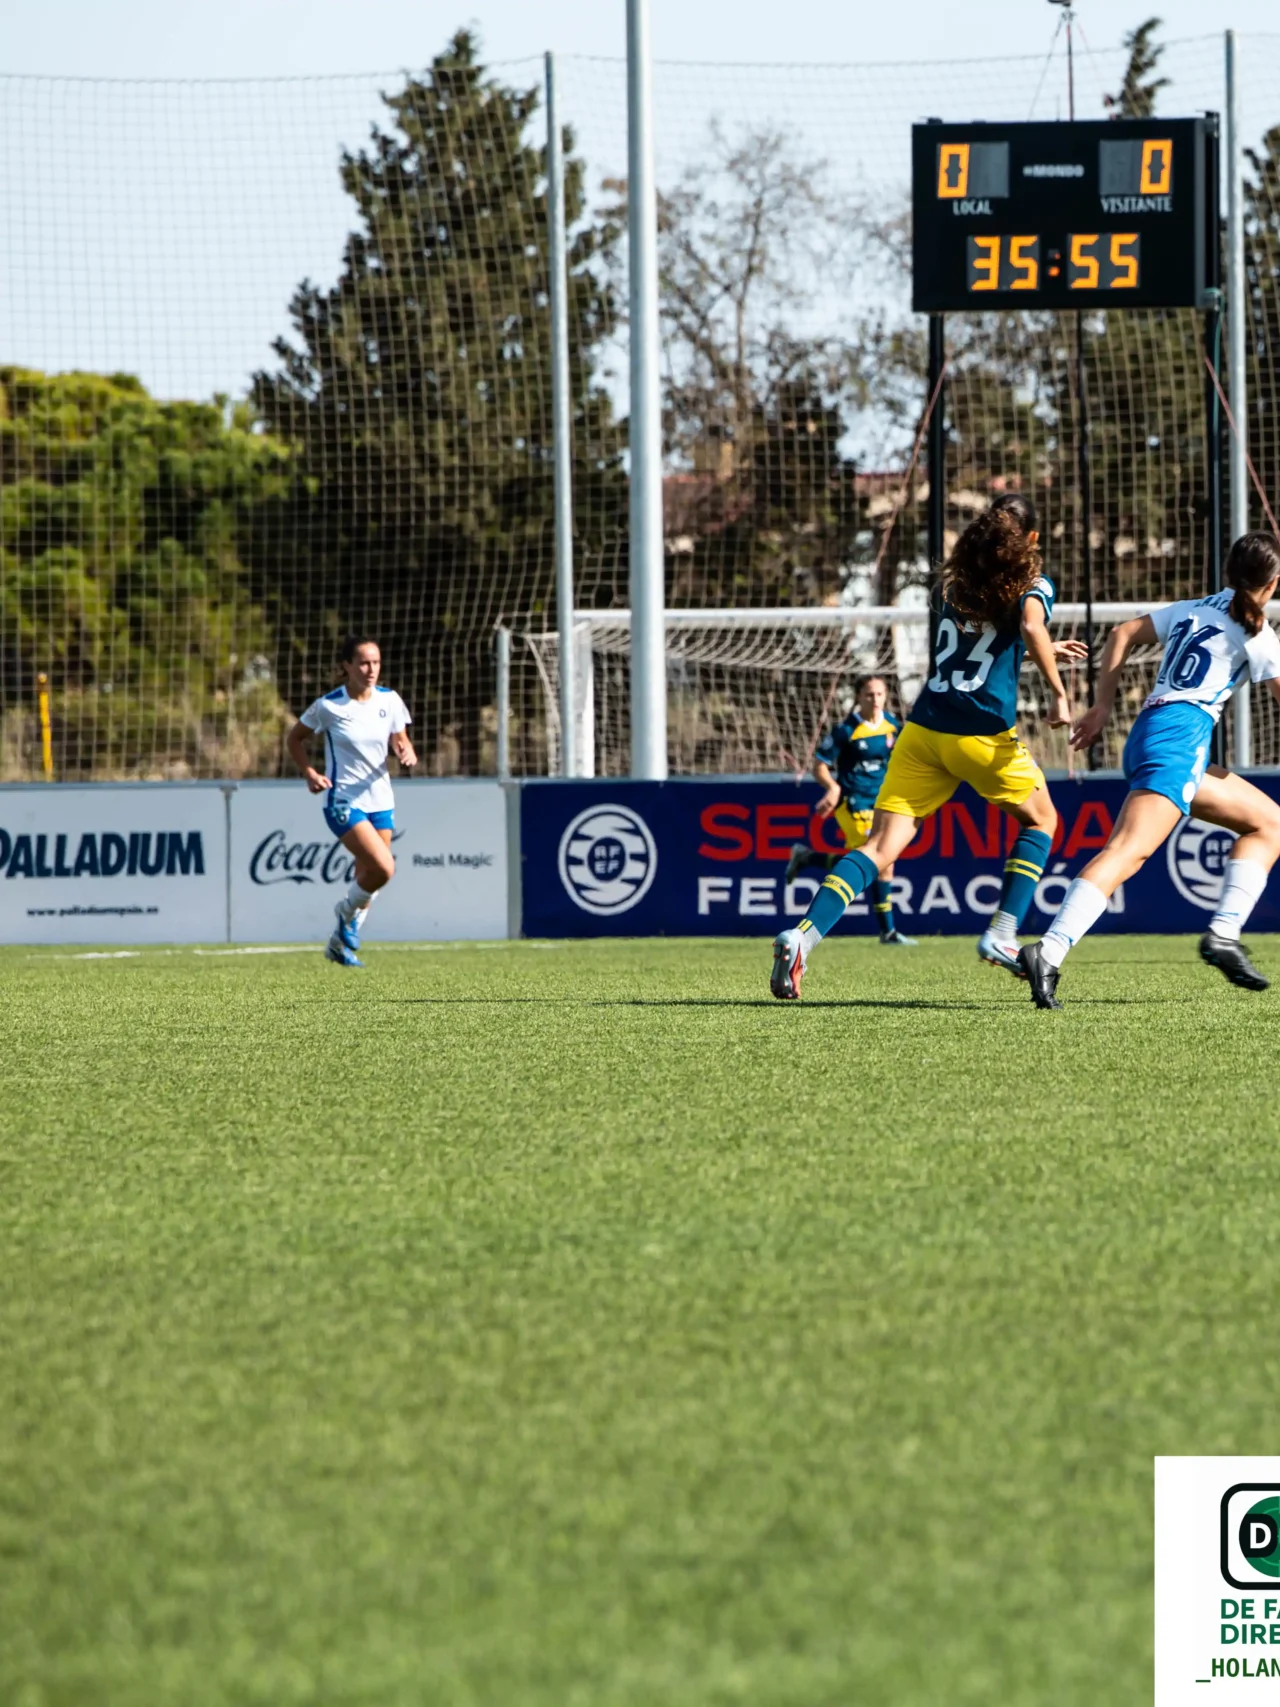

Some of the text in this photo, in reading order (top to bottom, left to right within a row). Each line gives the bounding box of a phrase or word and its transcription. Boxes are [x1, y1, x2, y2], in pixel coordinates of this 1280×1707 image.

[938, 143, 970, 198] 0
[1140, 139, 1172, 194] 0
[953, 200, 993, 215] LOCAL
[1101, 196, 1173, 213] VISITANTE
[971, 233, 1139, 291] 35:55
[928, 618, 997, 692] 23
[1157, 618, 1225, 691] 16
[412, 852, 494, 869] Real Magic
